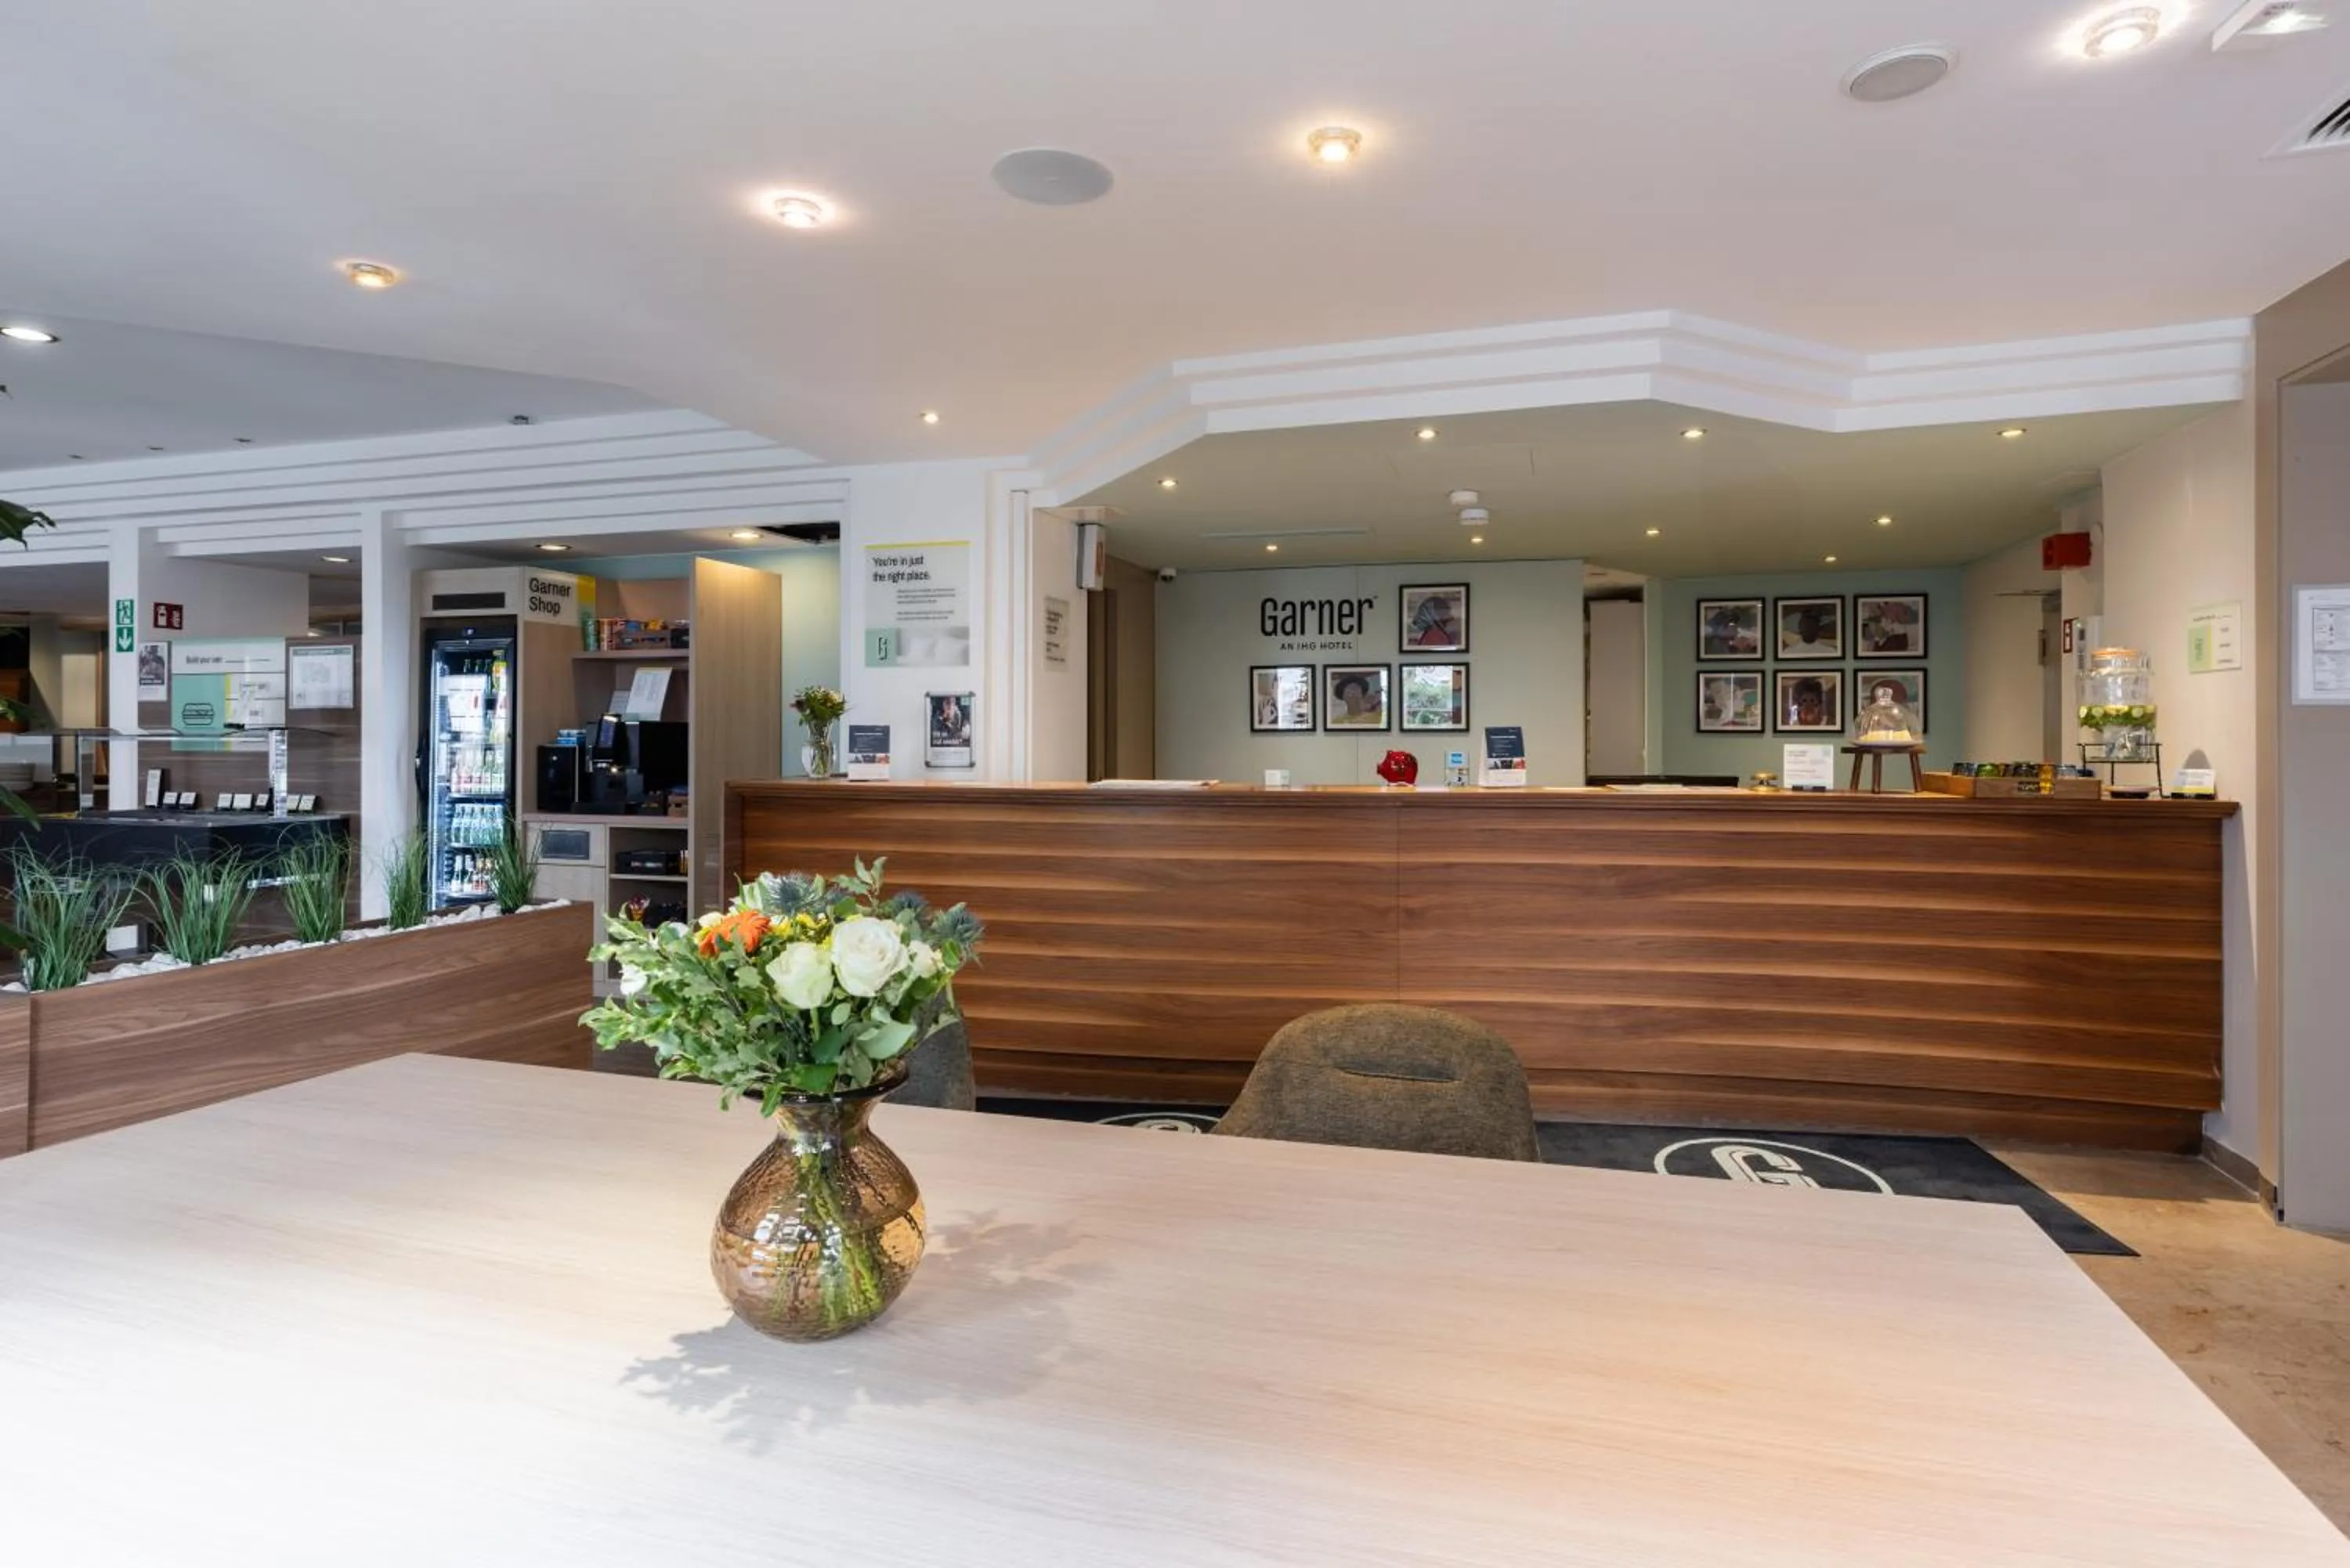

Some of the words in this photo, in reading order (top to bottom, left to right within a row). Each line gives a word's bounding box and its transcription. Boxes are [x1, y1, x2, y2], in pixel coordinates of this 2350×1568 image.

[873, 557, 898, 566] You're
[900, 556, 908, 565] in
[909, 555, 924, 567] just
[873, 572, 886, 582] the
[888, 571, 906, 583] right
[529, 577, 571, 598] Garner
[529, 596, 561, 616] Shop
[1260, 598, 1374, 636] Garner
[1297, 641, 1317, 650] IHG
[1320, 641, 1353, 650] HOTEL
